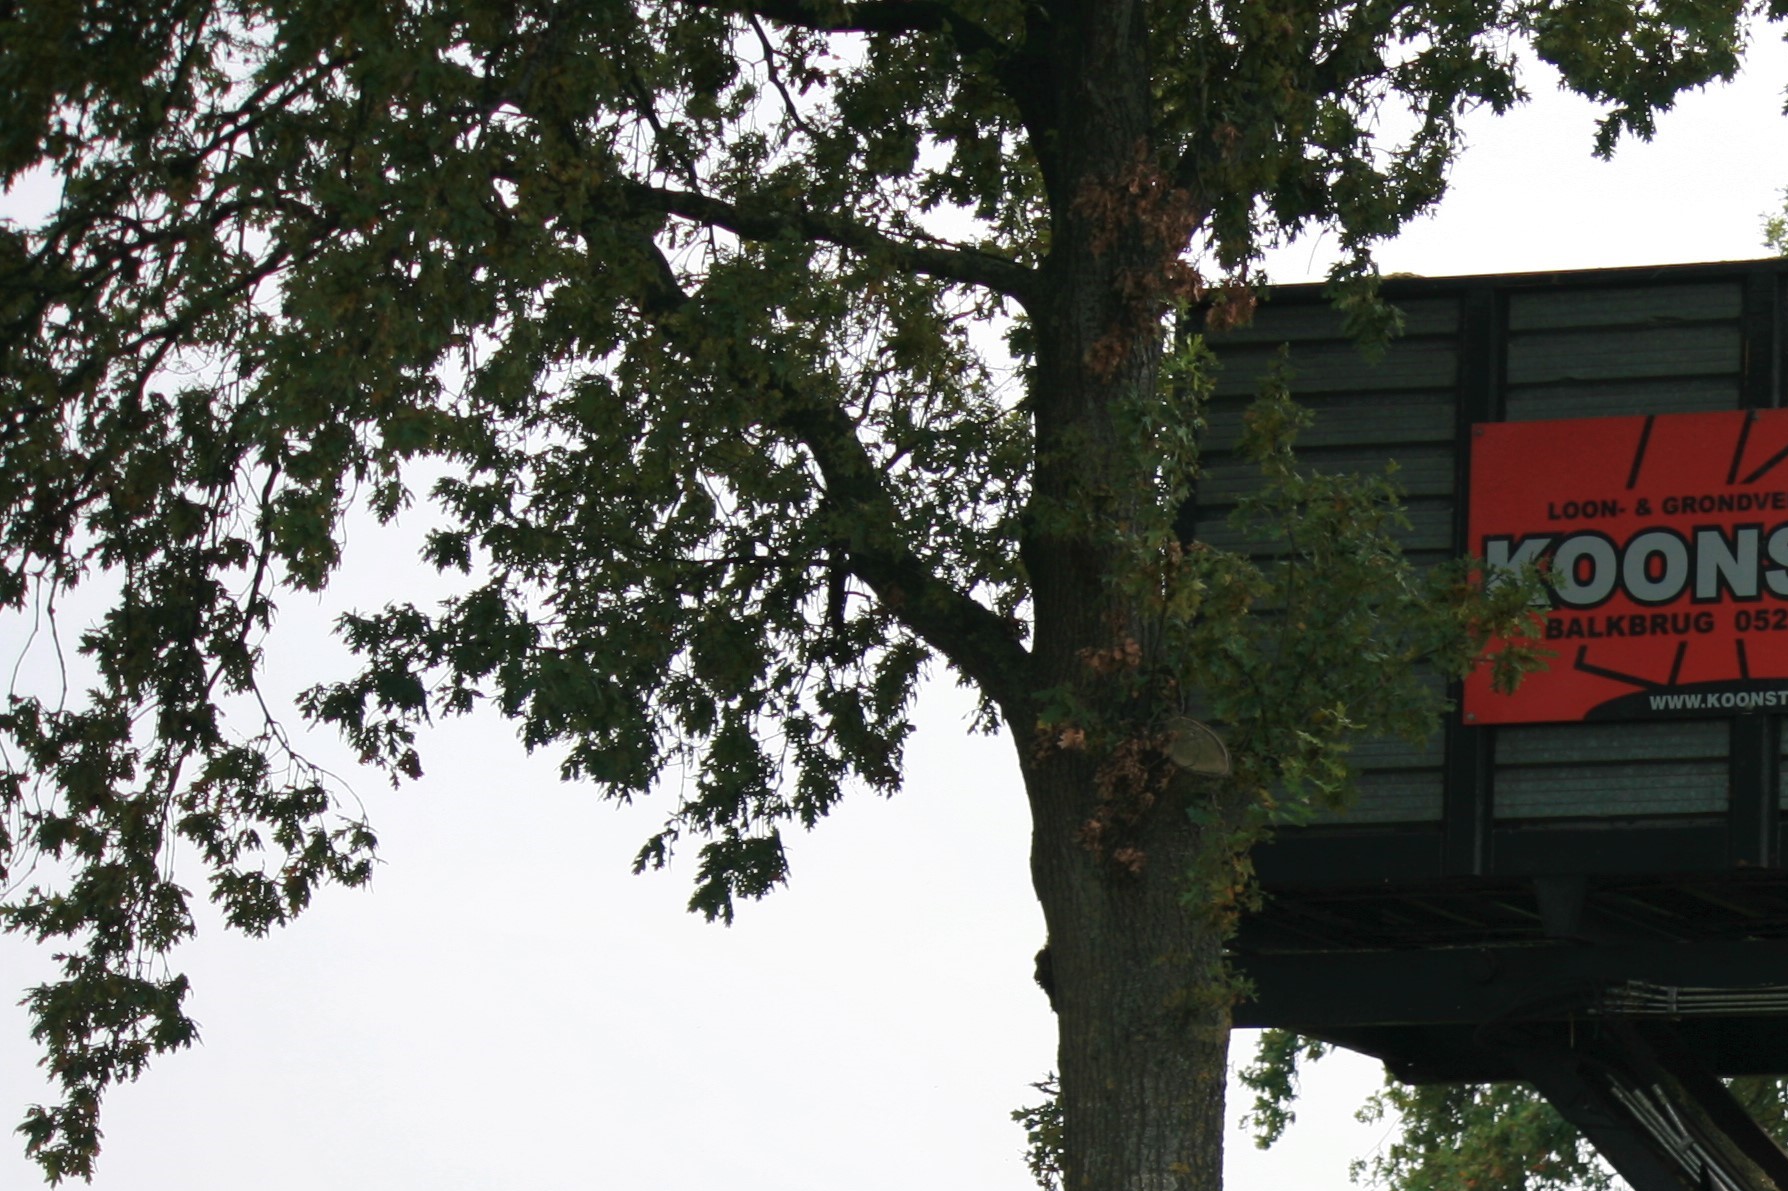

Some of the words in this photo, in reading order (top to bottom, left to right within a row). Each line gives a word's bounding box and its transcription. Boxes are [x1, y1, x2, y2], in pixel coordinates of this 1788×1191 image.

[1548, 501, 1626, 520] LOON-
[1635, 498, 1653, 516] &
[1545, 611, 1715, 640] BALKBRUG
